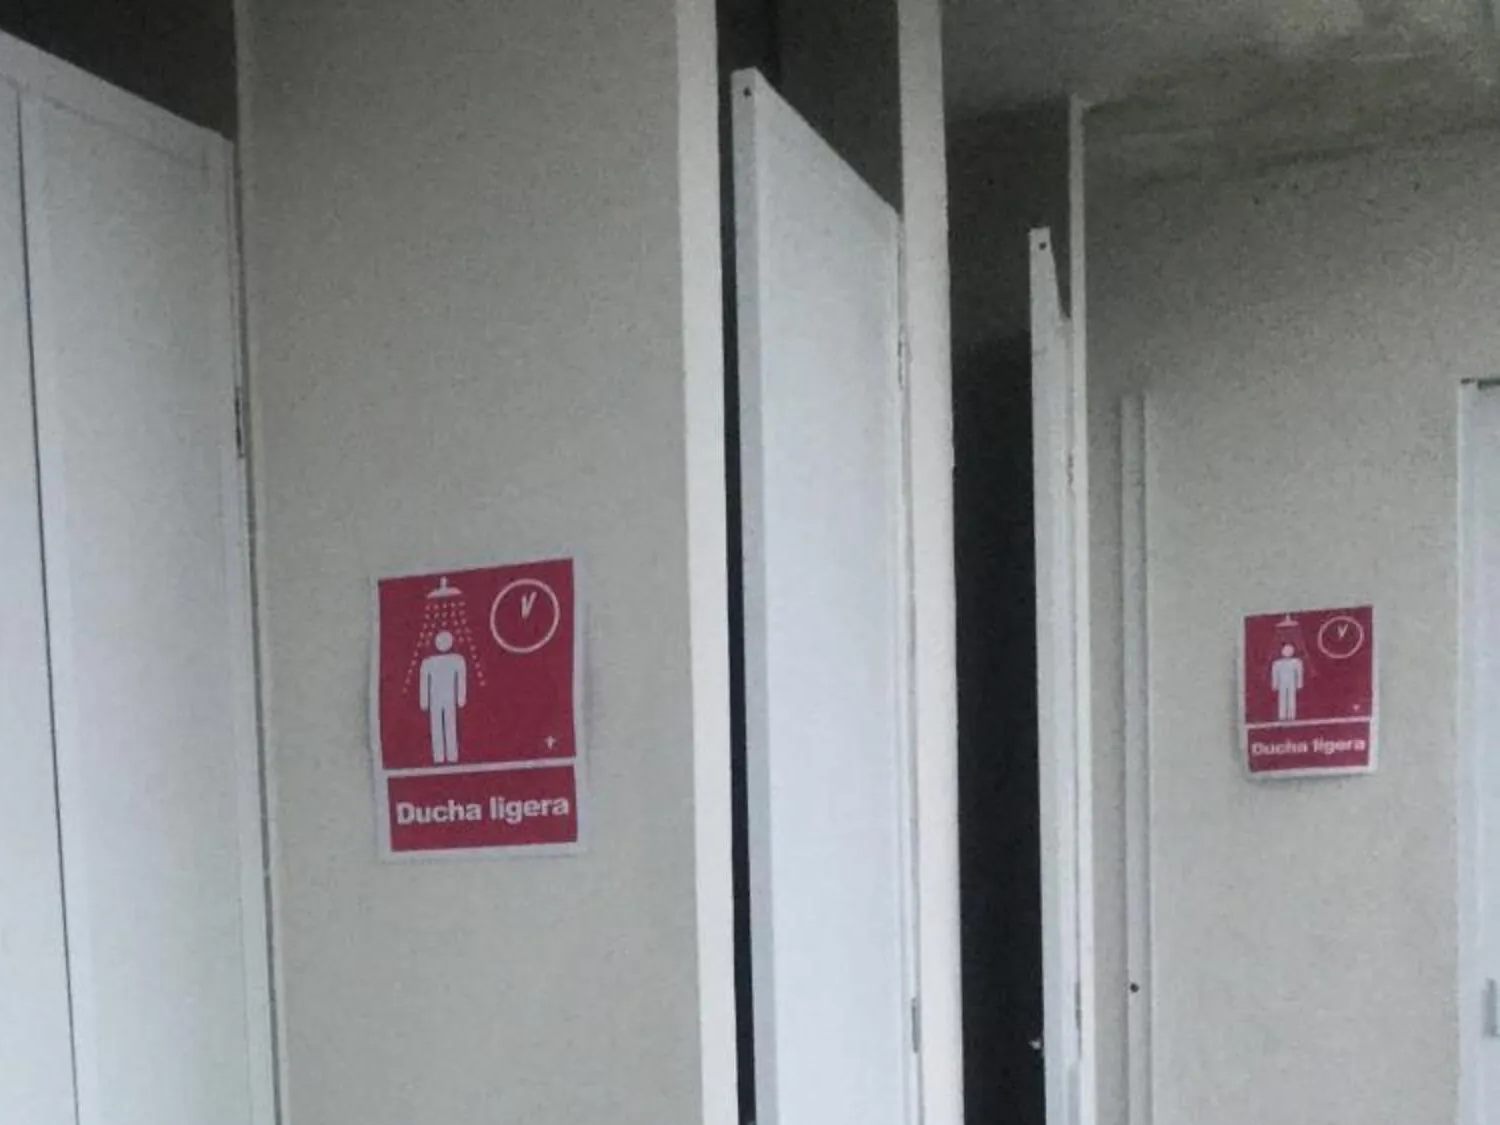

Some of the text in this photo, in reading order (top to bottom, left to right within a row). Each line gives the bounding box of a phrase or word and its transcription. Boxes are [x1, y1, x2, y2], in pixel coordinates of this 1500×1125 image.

[1251, 736, 1365, 755] Ducha ligera
[396, 796, 569, 824] Ducha ligera
